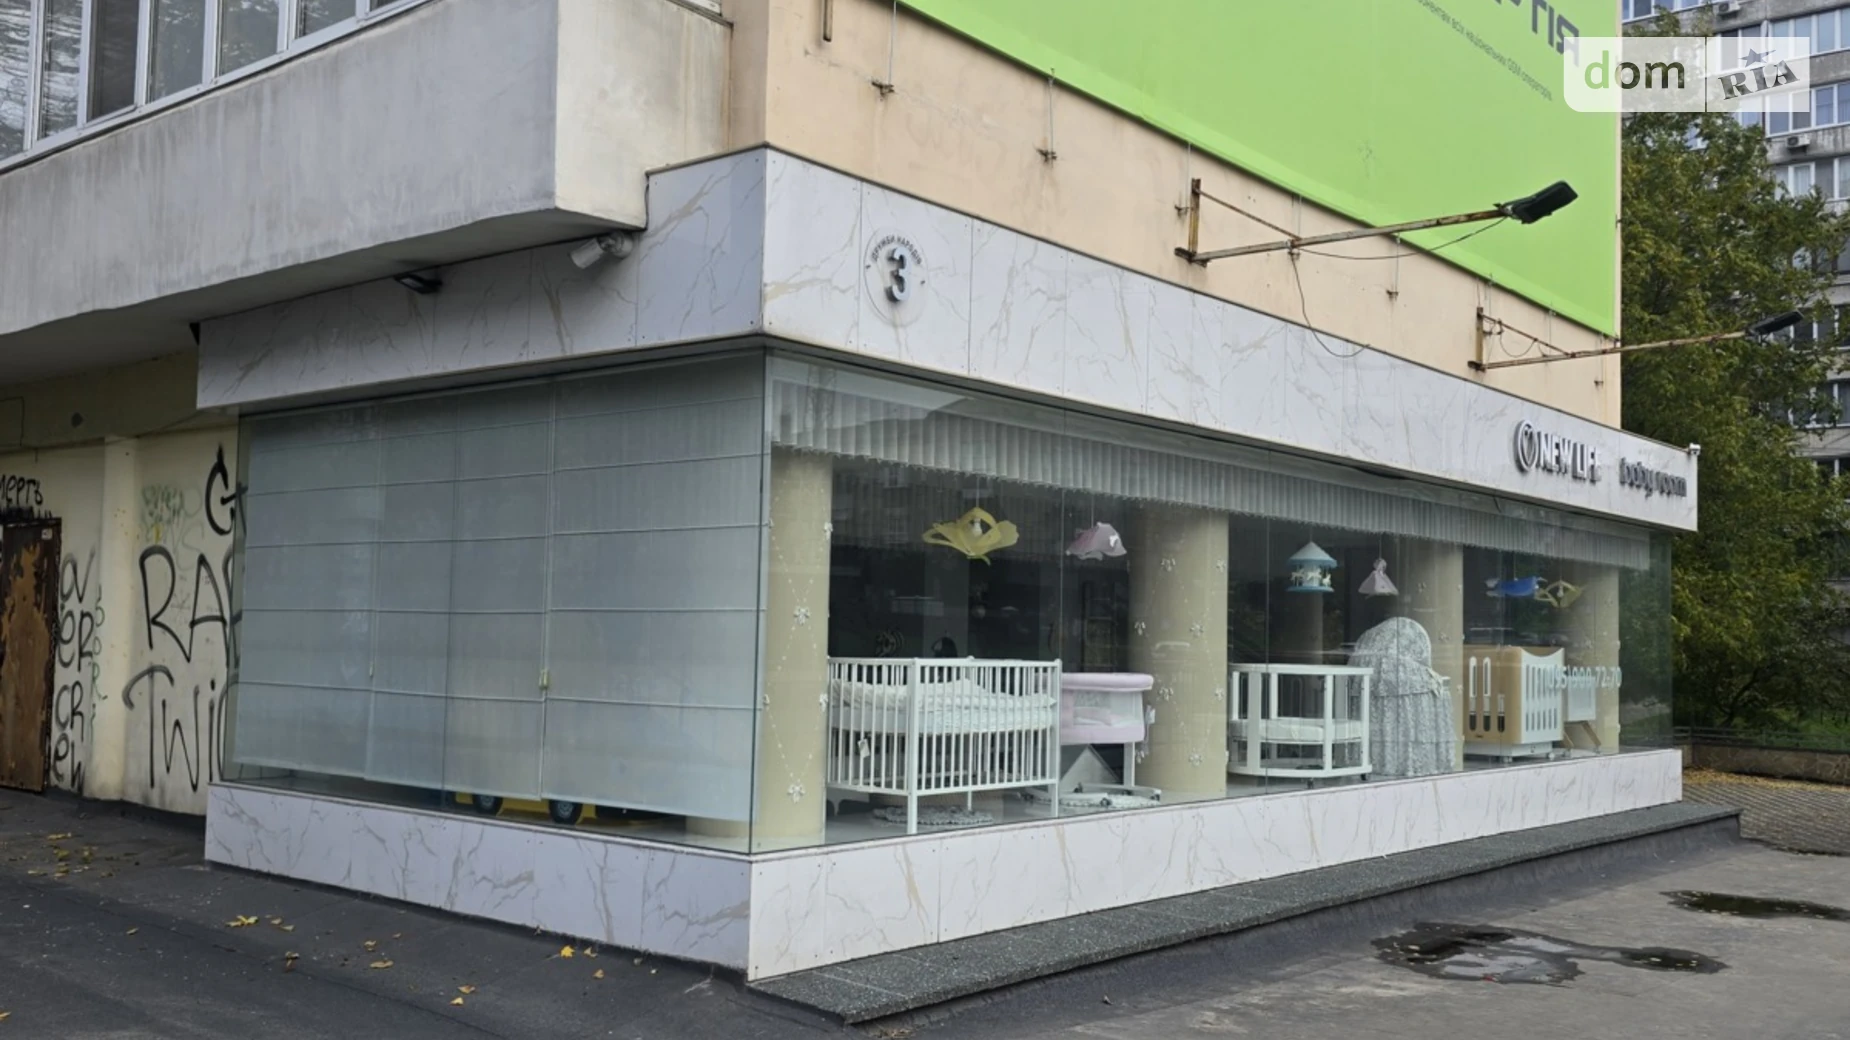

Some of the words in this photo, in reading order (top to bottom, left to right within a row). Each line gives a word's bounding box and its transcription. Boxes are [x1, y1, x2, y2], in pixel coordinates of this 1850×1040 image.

[1494, 0, 1580, 67] ГІЯ
[884, 246, 911, 303] 3
[1537, 431, 1572, 475] NEW
